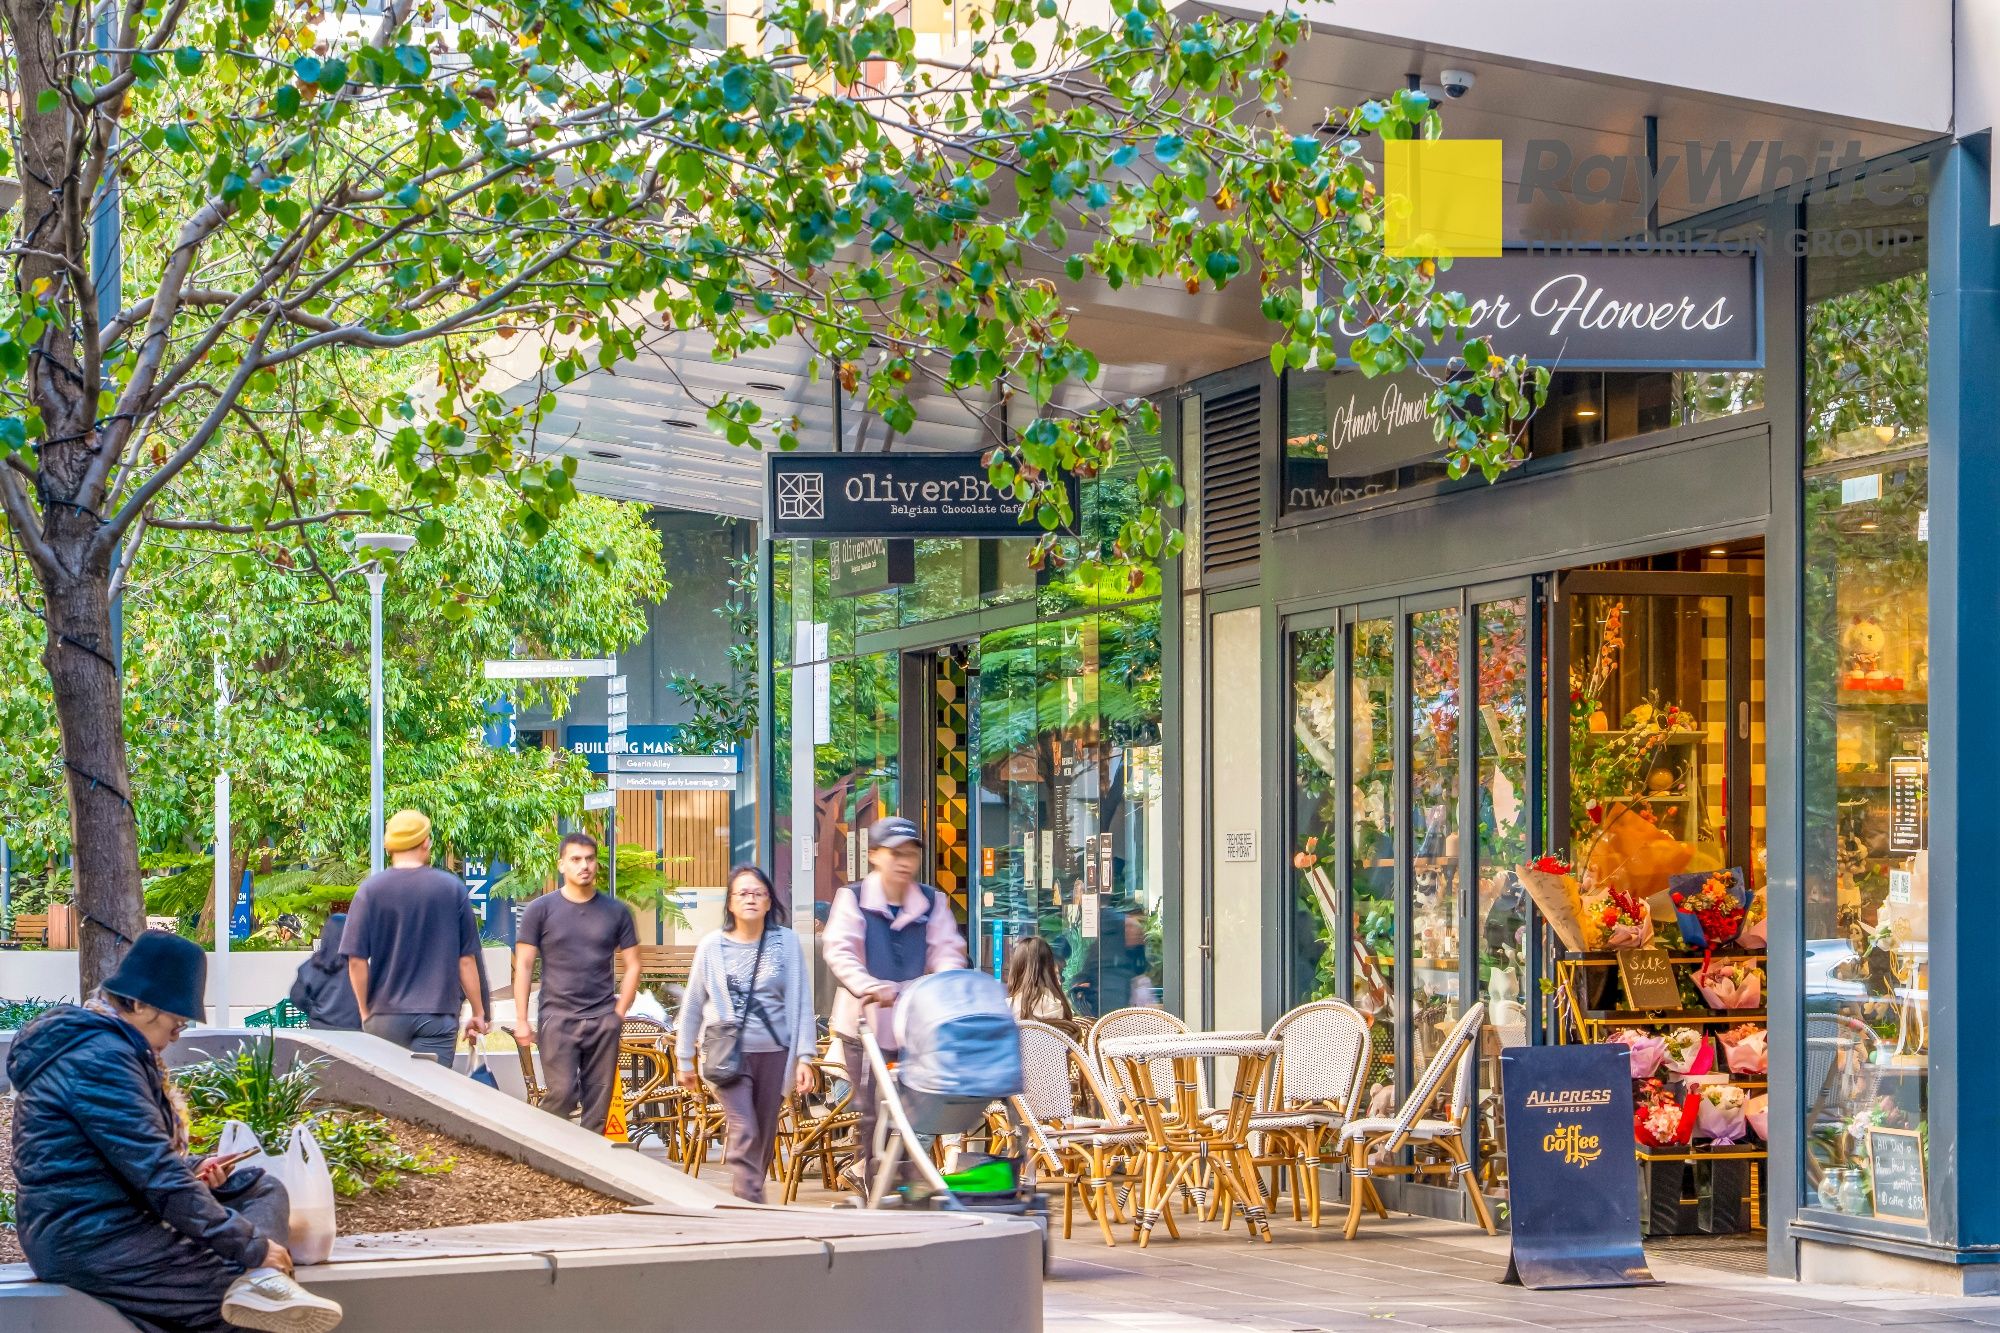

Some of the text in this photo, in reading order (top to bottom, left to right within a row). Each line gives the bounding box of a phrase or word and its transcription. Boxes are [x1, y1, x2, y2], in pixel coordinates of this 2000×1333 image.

[1529, 273, 1734, 336] Flowers
[1332, 394, 1381, 450] Amor
[890, 504, 938, 518] Belgian
[941, 504, 997, 514] Chocolate
[1526, 1089, 1612, 1107] ALLPRESS
[1546, 1105, 1592, 1114] ESPRESSO
[1543, 1124, 1602, 1165] Coffee
